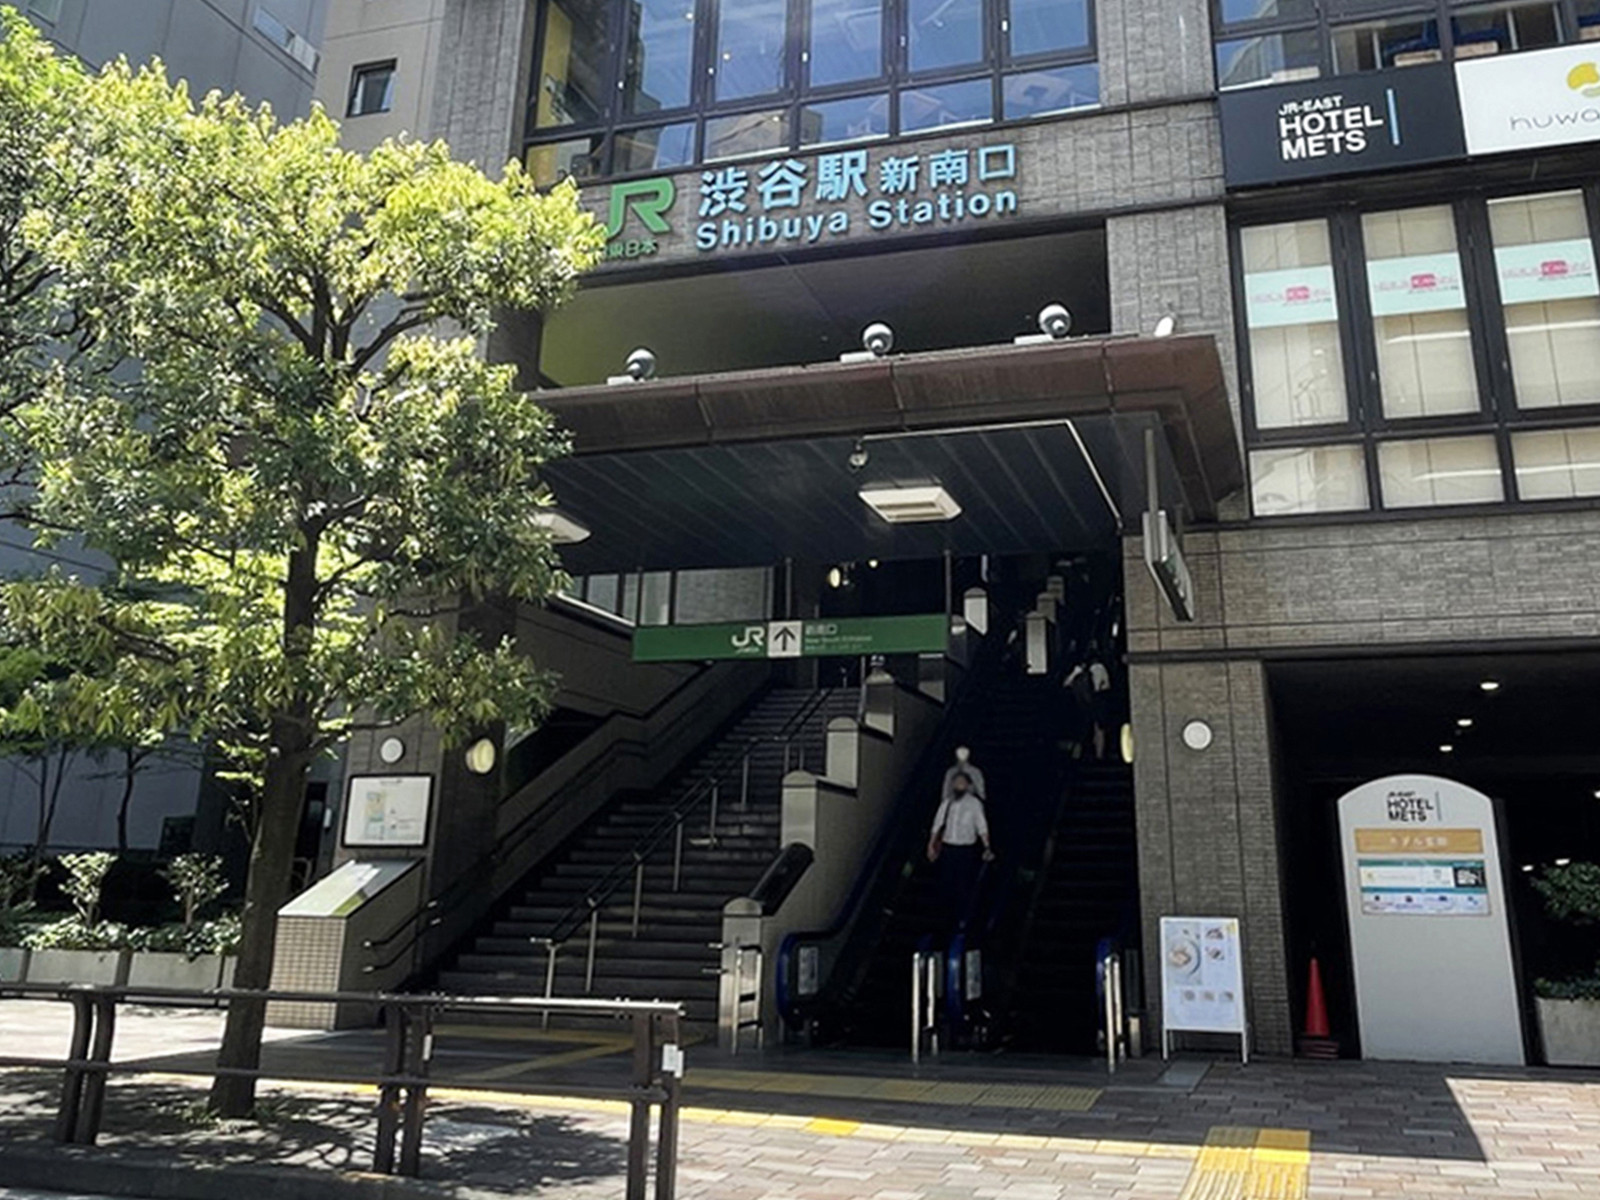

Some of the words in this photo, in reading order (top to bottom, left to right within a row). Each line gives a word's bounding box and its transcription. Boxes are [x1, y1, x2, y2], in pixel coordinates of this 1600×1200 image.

[1279, 96, 1342, 115] JR-EAST
[1280, 105, 1383, 138] HOTEL
[1282, 129, 1366, 160] METS
[699, 150, 868, 217] 渋谷駅
[880, 144, 1015, 194] 新南口
[606, 178, 674, 238] JR
[696, 210, 848, 250] Shibuya
[869, 190, 1016, 229] Station
[731, 626, 765, 647] JR
[1388, 798, 1434, 810] HOTEL
